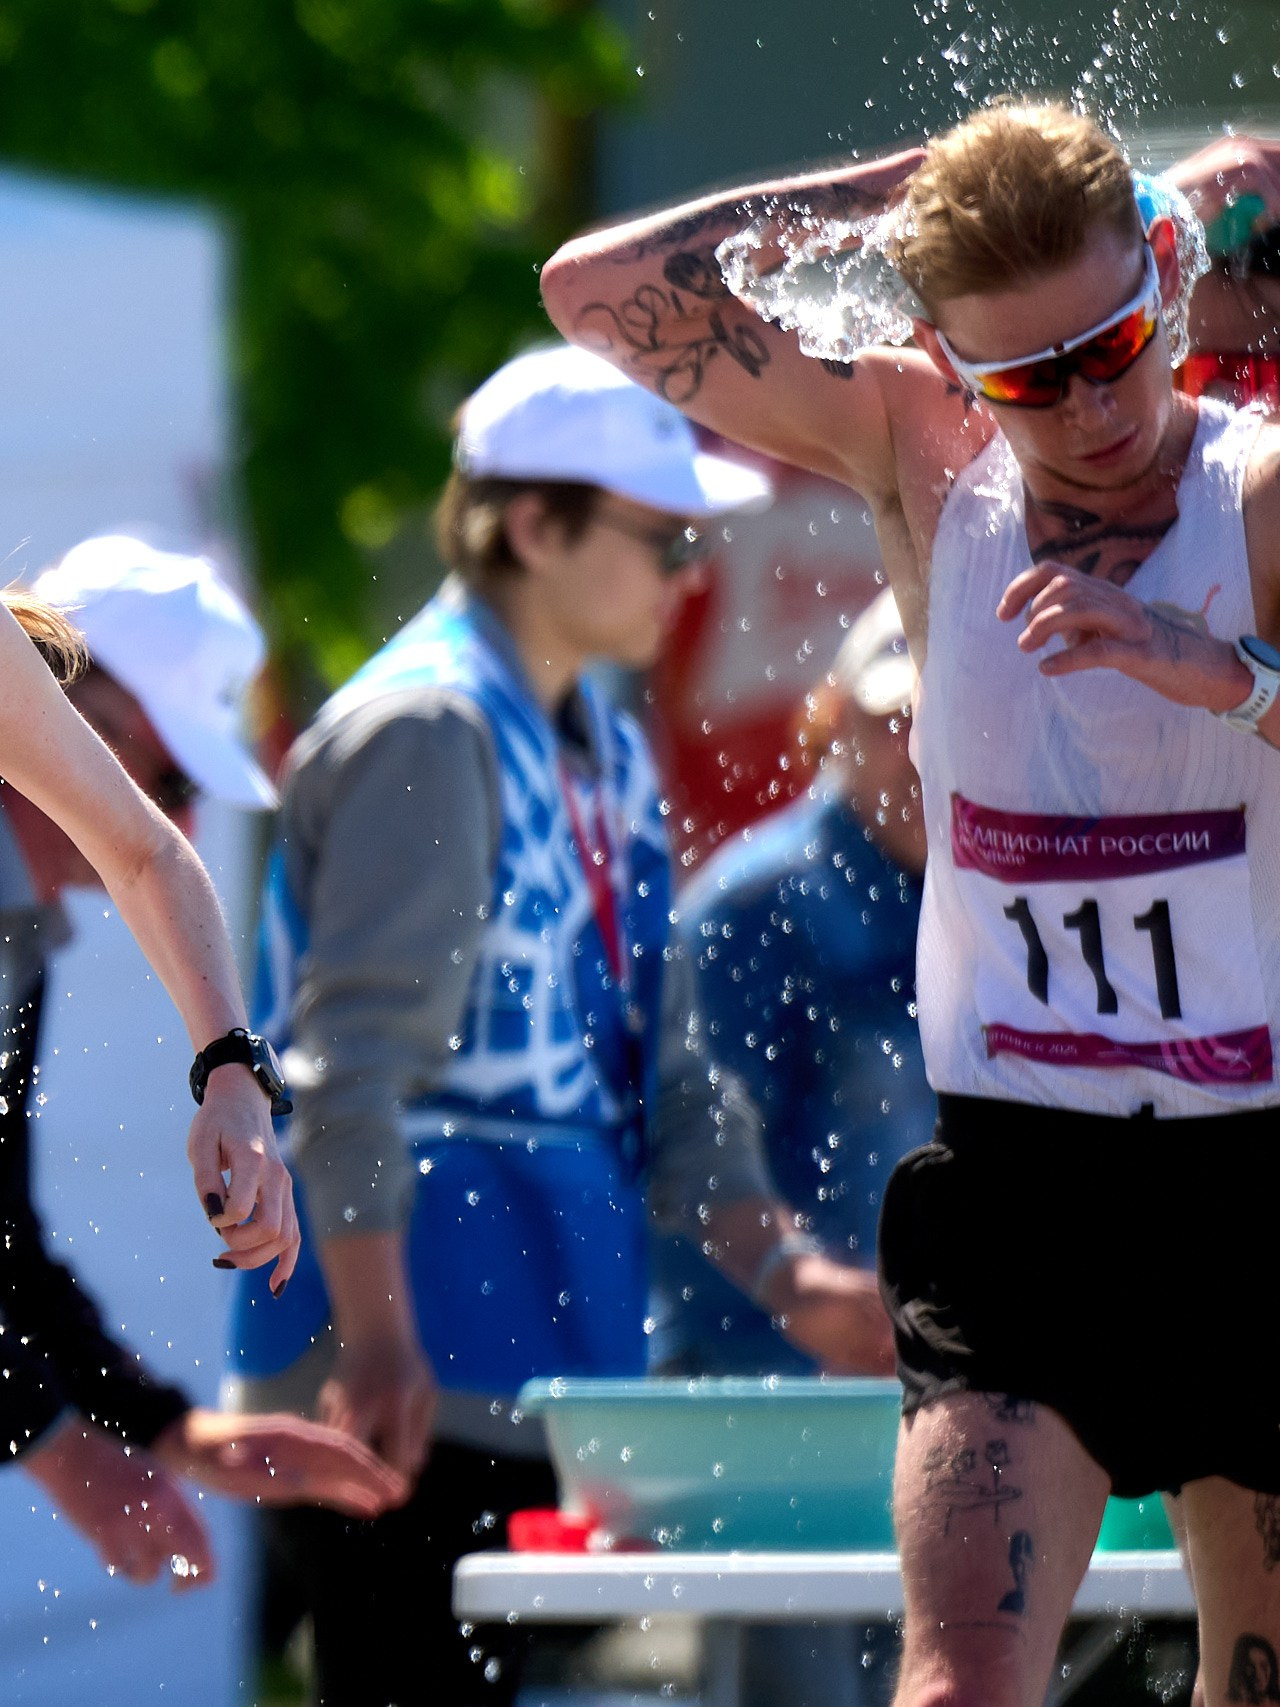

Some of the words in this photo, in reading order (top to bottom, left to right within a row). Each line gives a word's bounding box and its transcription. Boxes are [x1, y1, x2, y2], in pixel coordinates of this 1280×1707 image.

[959, 820, 1093, 856] МПИОНАТ
[1101, 830, 1210, 857] РОССИИ
[1004, 896, 1182, 1020] 111
